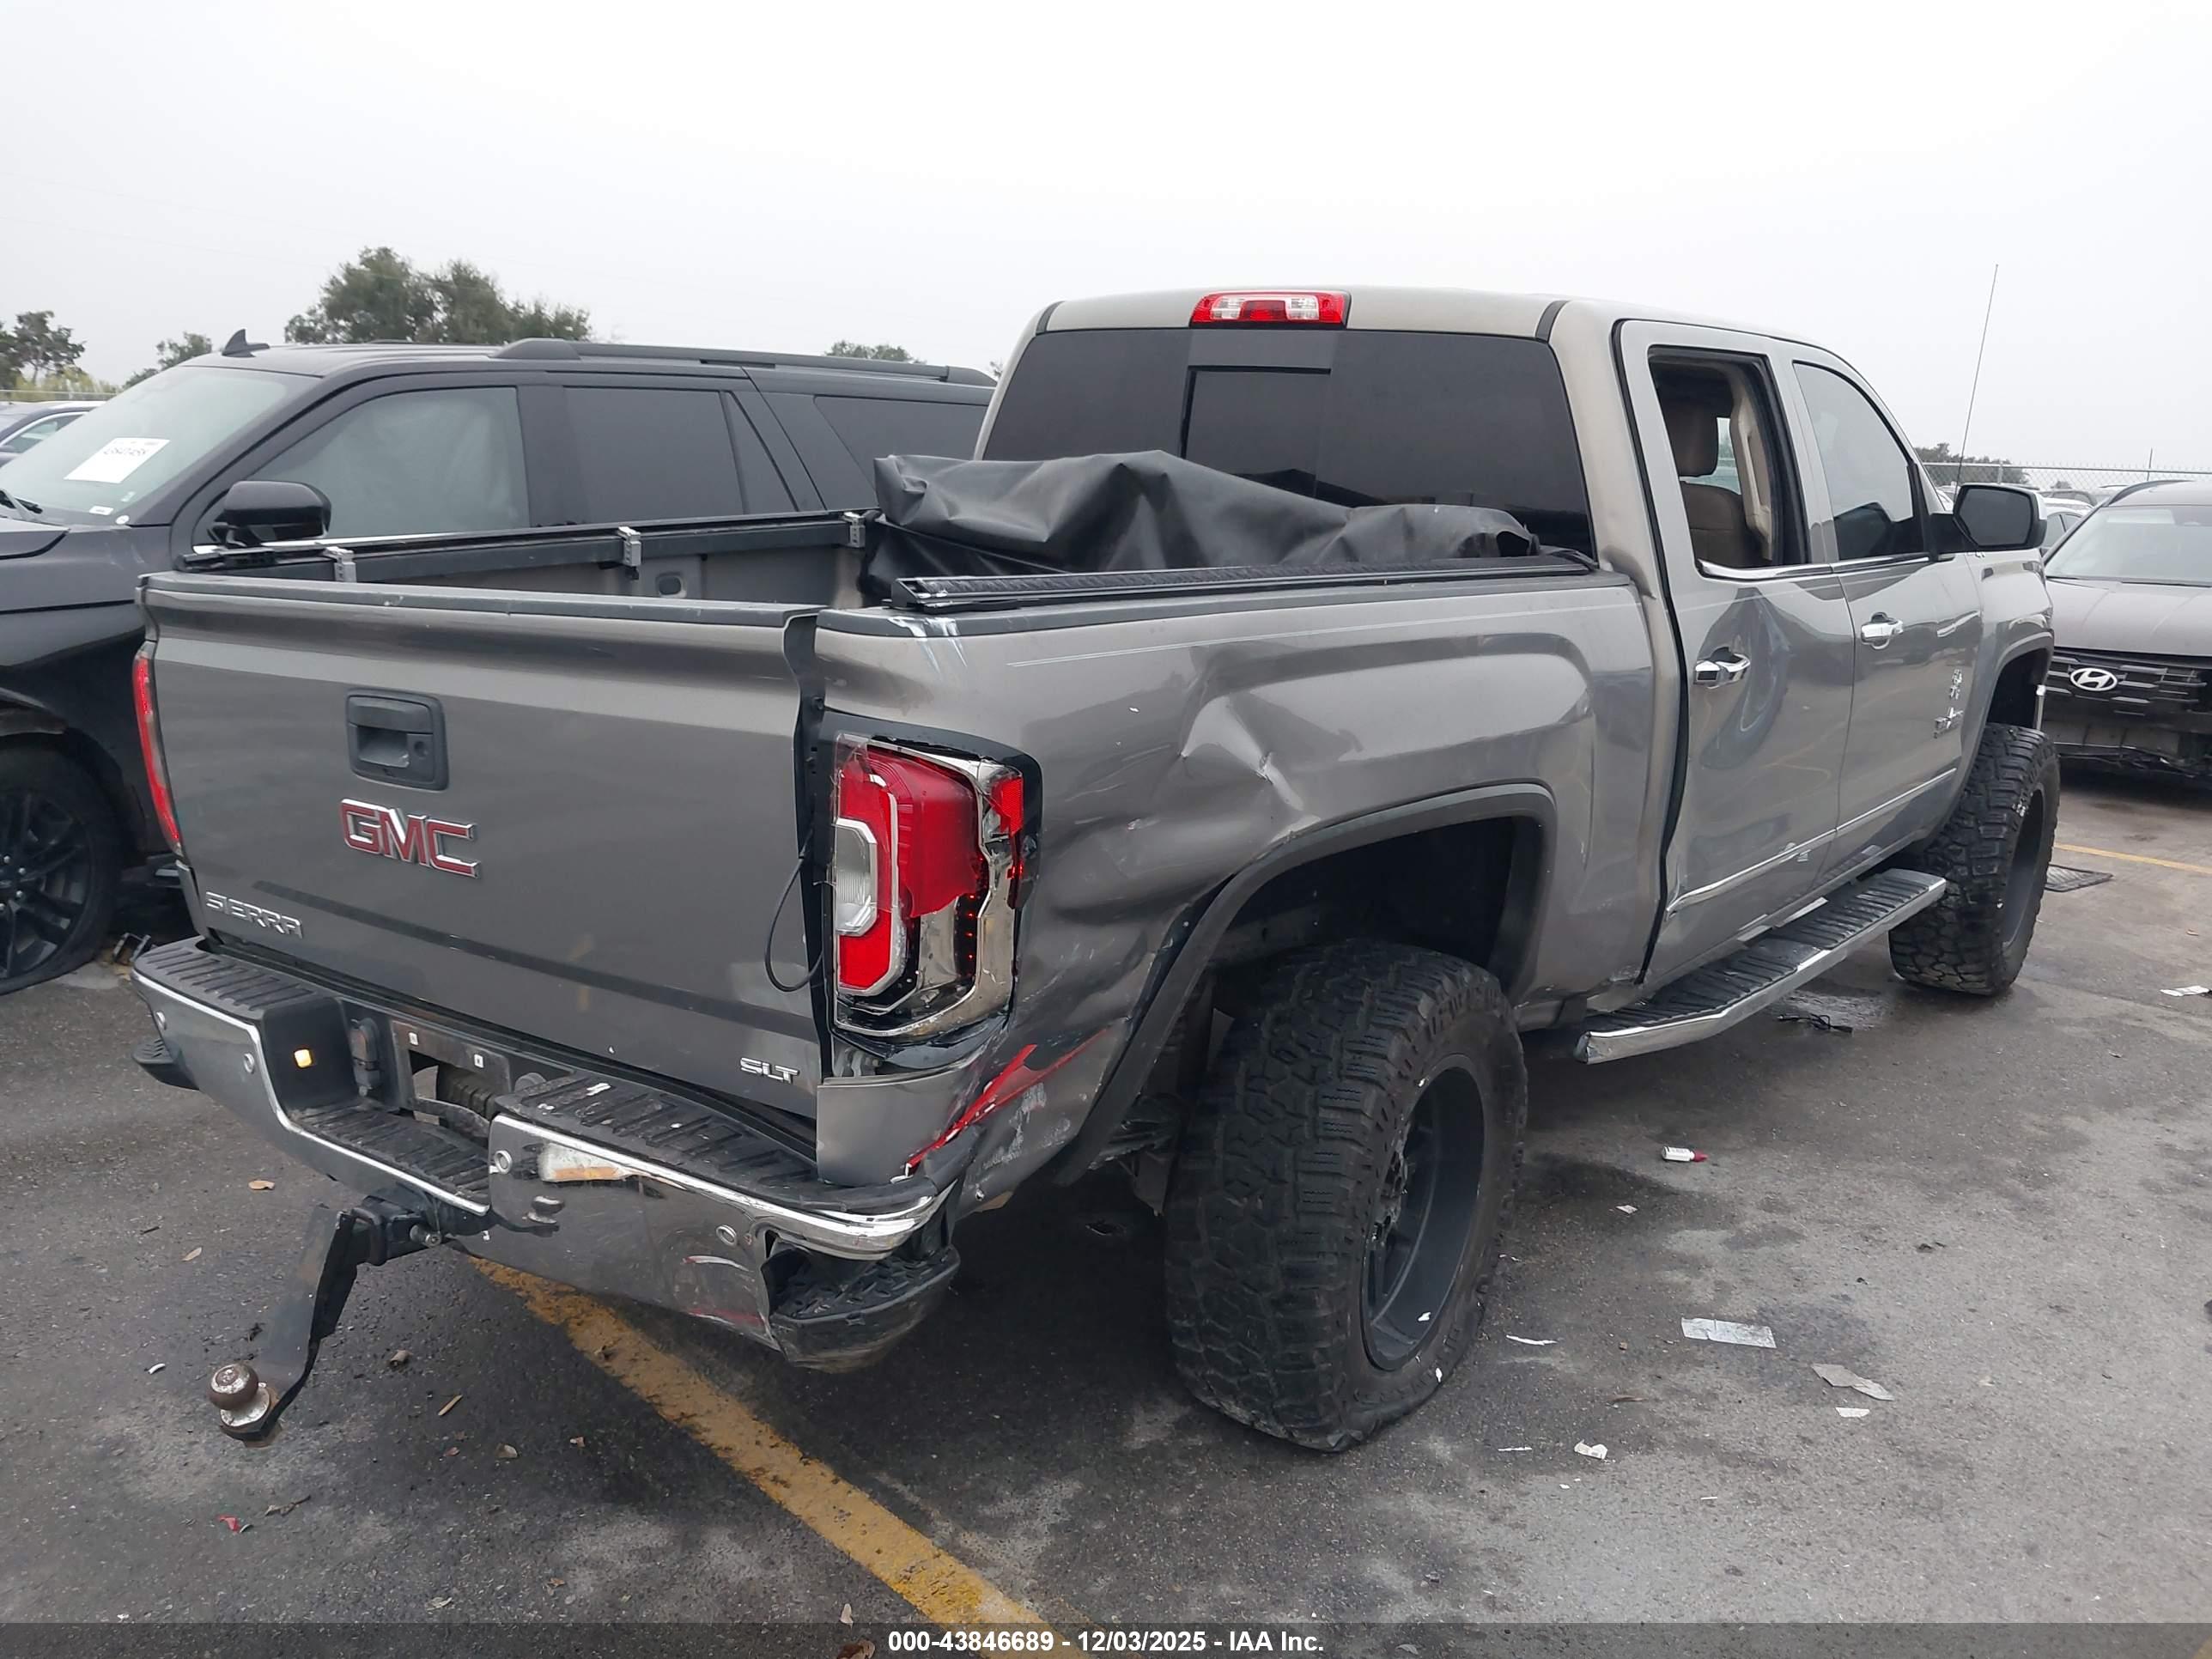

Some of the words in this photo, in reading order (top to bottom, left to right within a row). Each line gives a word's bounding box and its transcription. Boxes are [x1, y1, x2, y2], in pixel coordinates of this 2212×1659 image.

[341, 799, 482, 878] GMC
[206, 891, 303, 939] SIERRA
[740, 1057, 799, 1084] SLT
